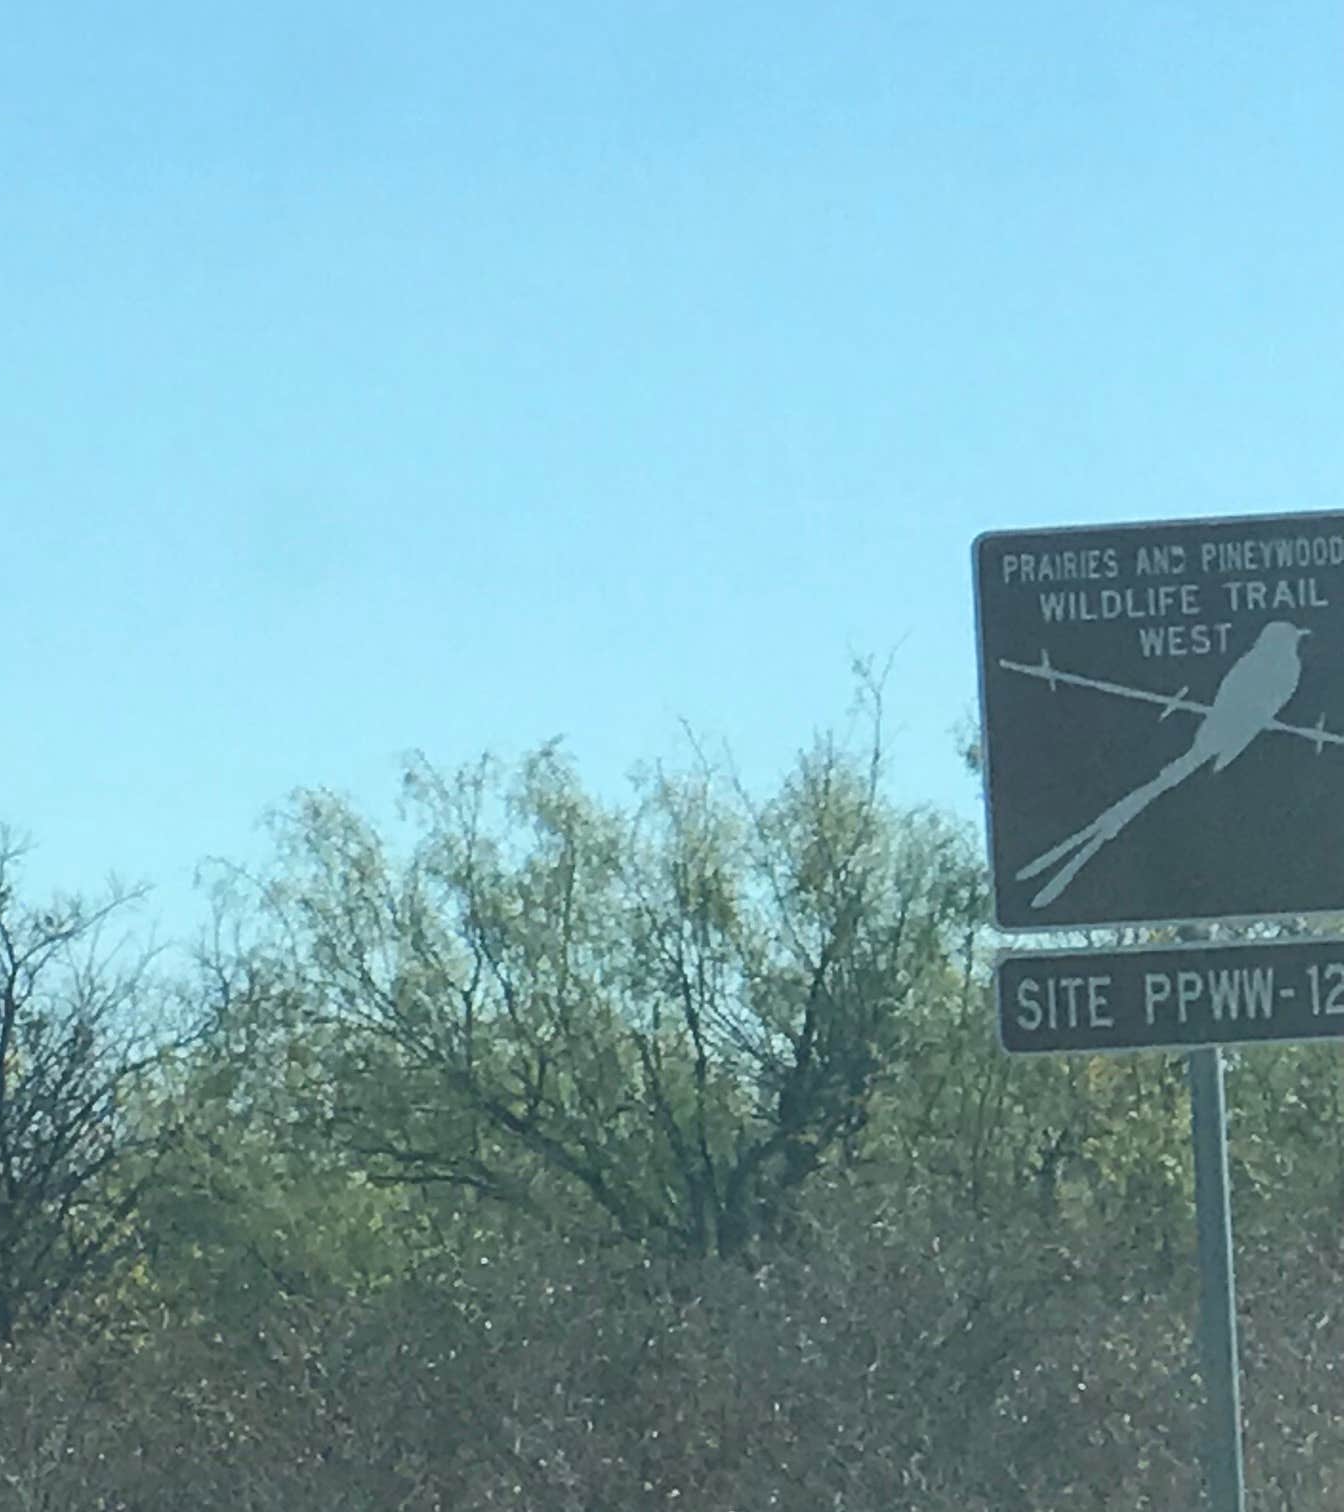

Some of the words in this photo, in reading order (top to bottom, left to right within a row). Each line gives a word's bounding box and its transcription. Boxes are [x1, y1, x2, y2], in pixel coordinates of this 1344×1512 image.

[1003, 550, 1119, 584] PRAIRIES
[1136, 546, 1186, 576] AND
[1040, 584, 1201, 622] WILDLIFE
[1221, 577, 1329, 612] TRAIL
[1139, 622, 1232, 657] WEST
[1016, 976, 1114, 1031] SITE
